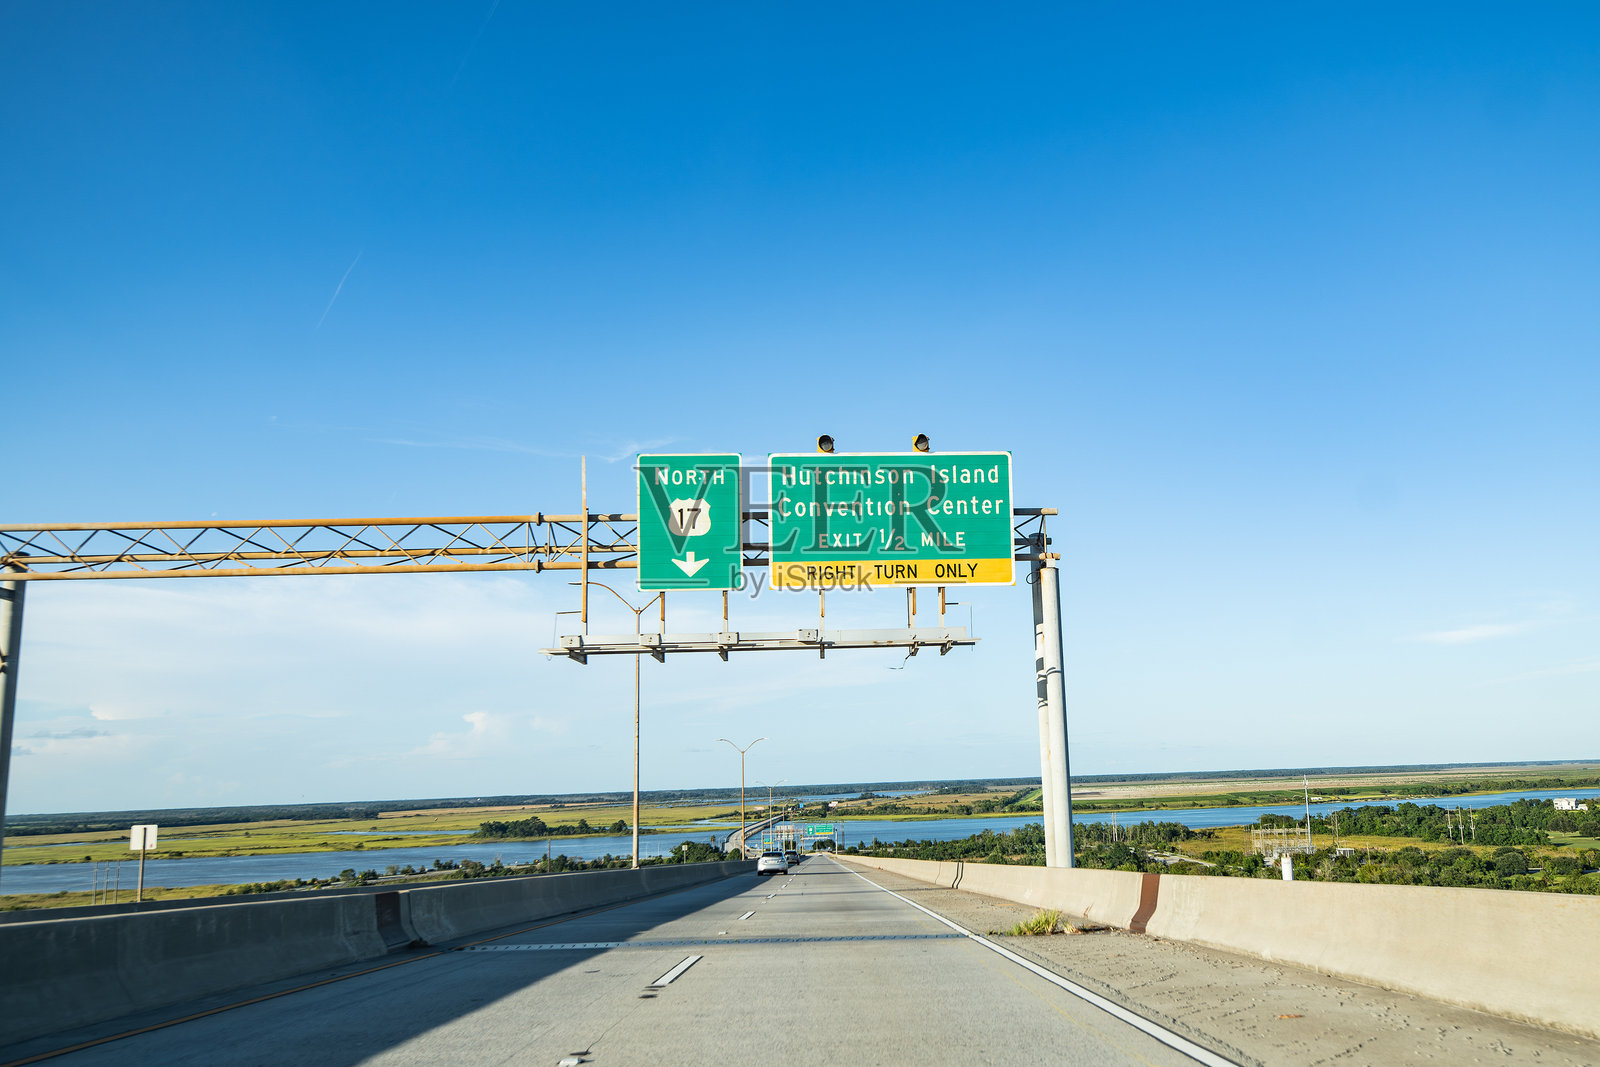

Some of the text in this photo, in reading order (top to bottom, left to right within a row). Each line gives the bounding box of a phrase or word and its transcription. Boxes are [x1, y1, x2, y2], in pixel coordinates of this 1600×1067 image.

[655, 467, 725, 486] NORTH
[781, 464, 999, 487] Hutchinson Island
[778, 495, 1004, 518] Convention Center
[676, 507, 702, 530] 17
[818, 532, 862, 549] EXIT
[921, 530, 966, 548] MILE
[806, 562, 979, 581] RIGHT TURN ONLY
